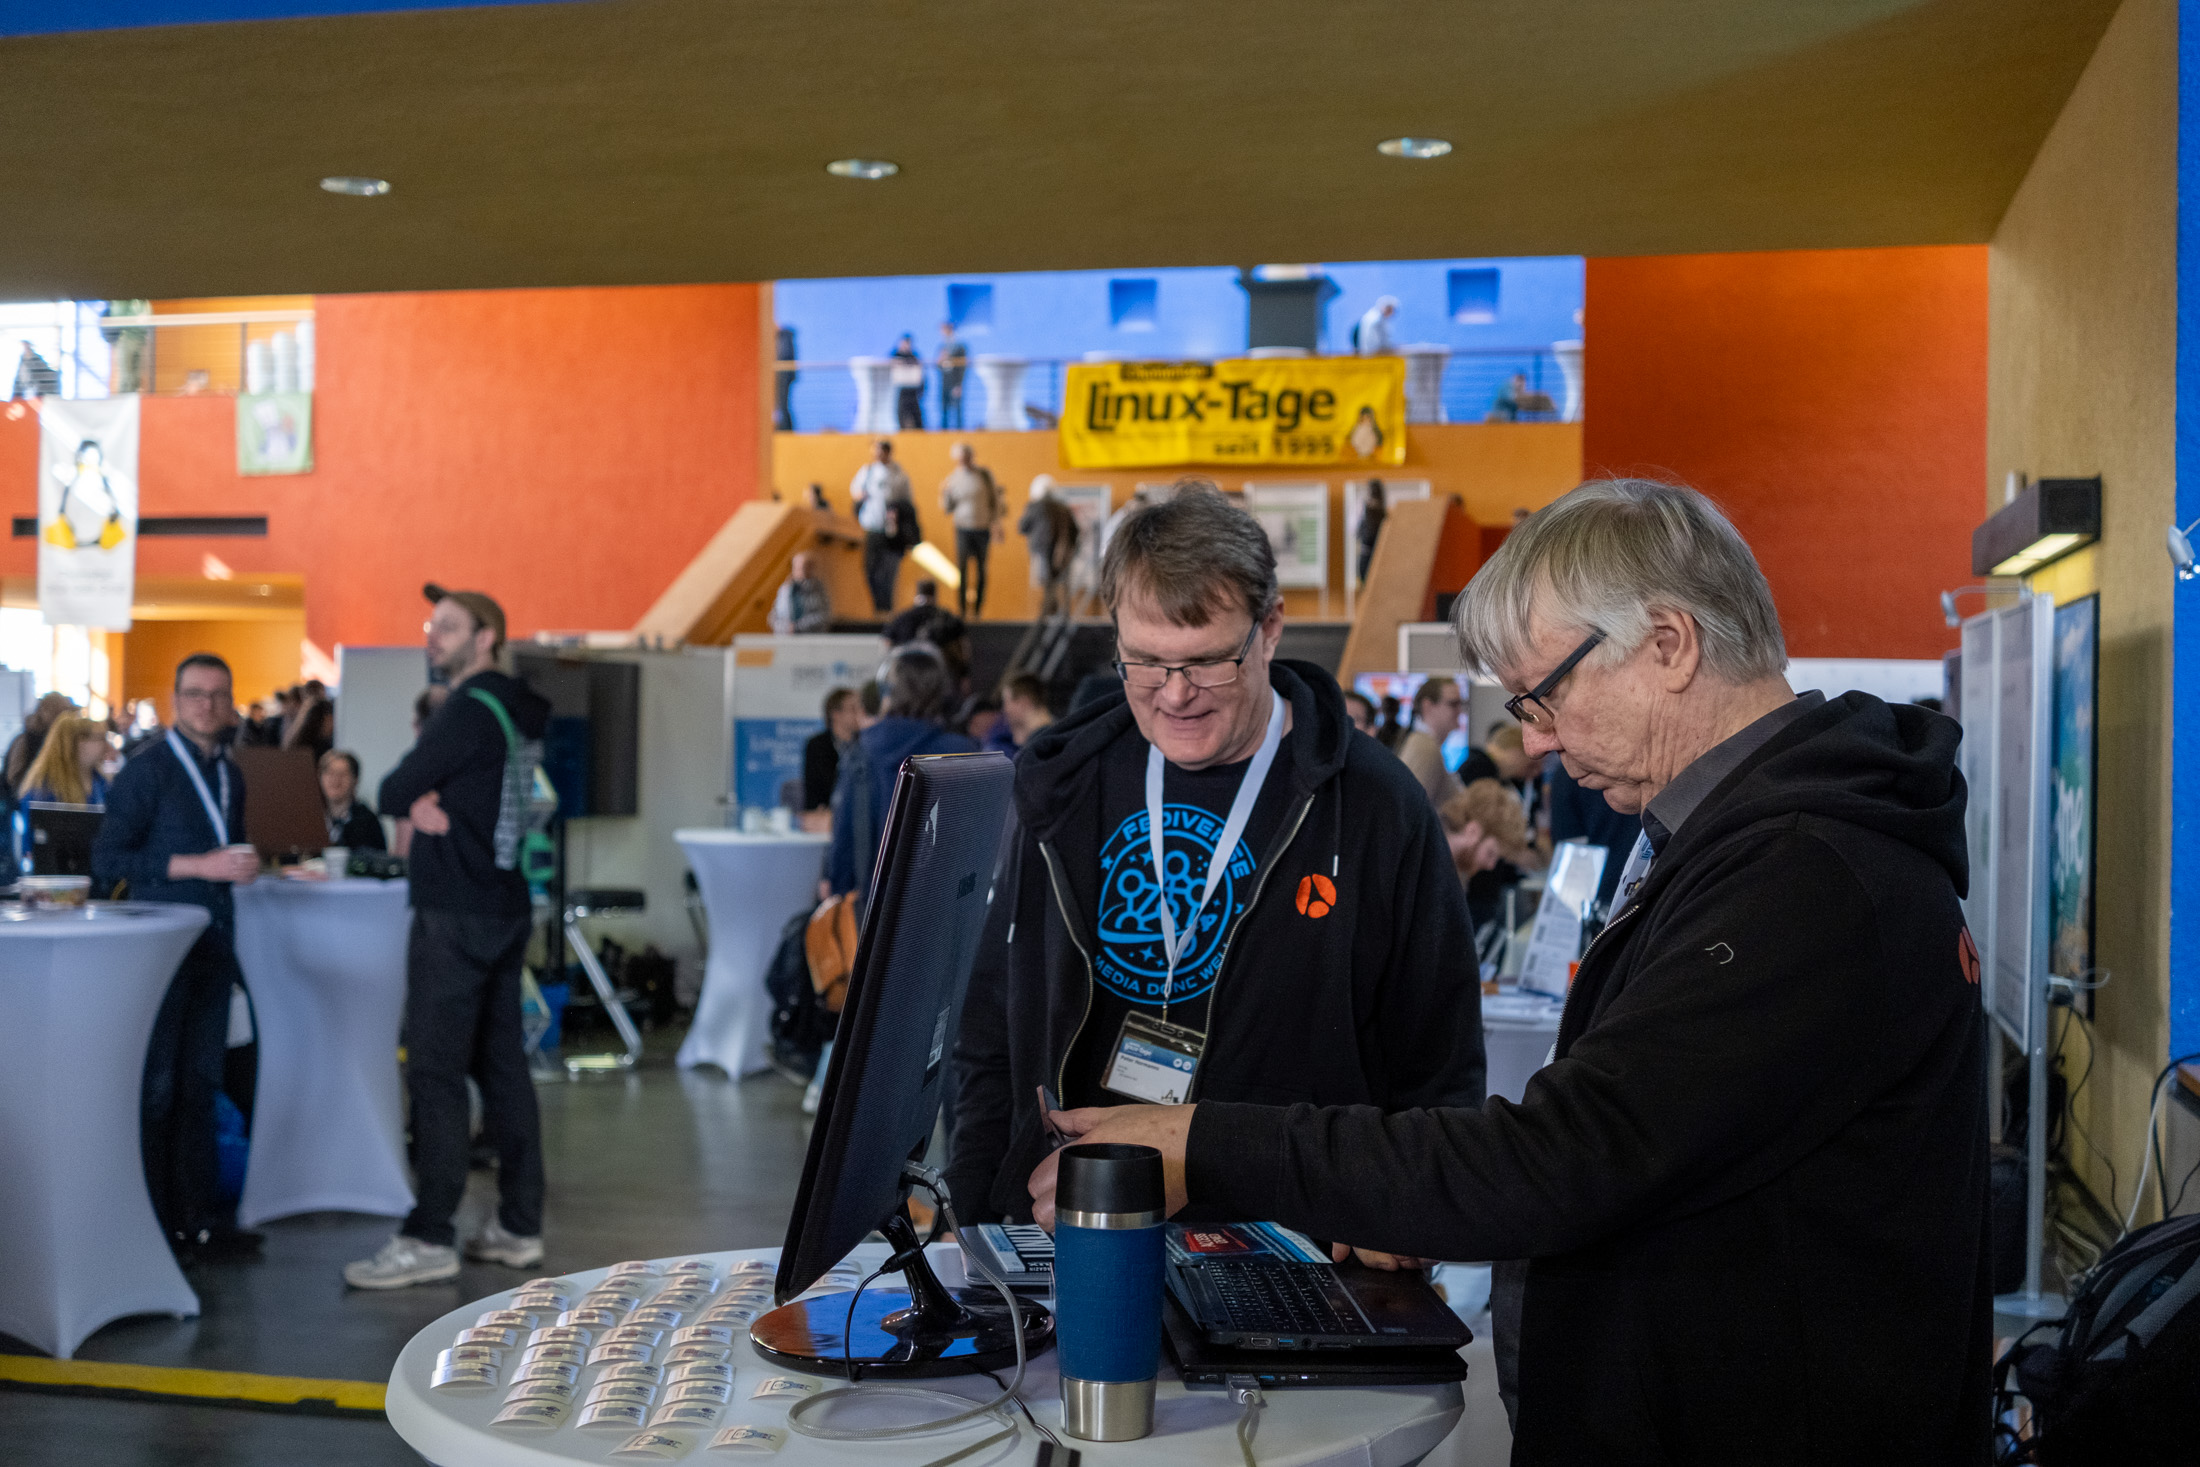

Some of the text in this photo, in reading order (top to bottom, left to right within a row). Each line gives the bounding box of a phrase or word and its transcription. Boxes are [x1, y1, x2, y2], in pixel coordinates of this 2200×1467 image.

[1087, 379, 1337, 433] Linux-Tage
[1095, 954, 1141, 993] MEDIA
[1199, 944, 1227, 980] WE
